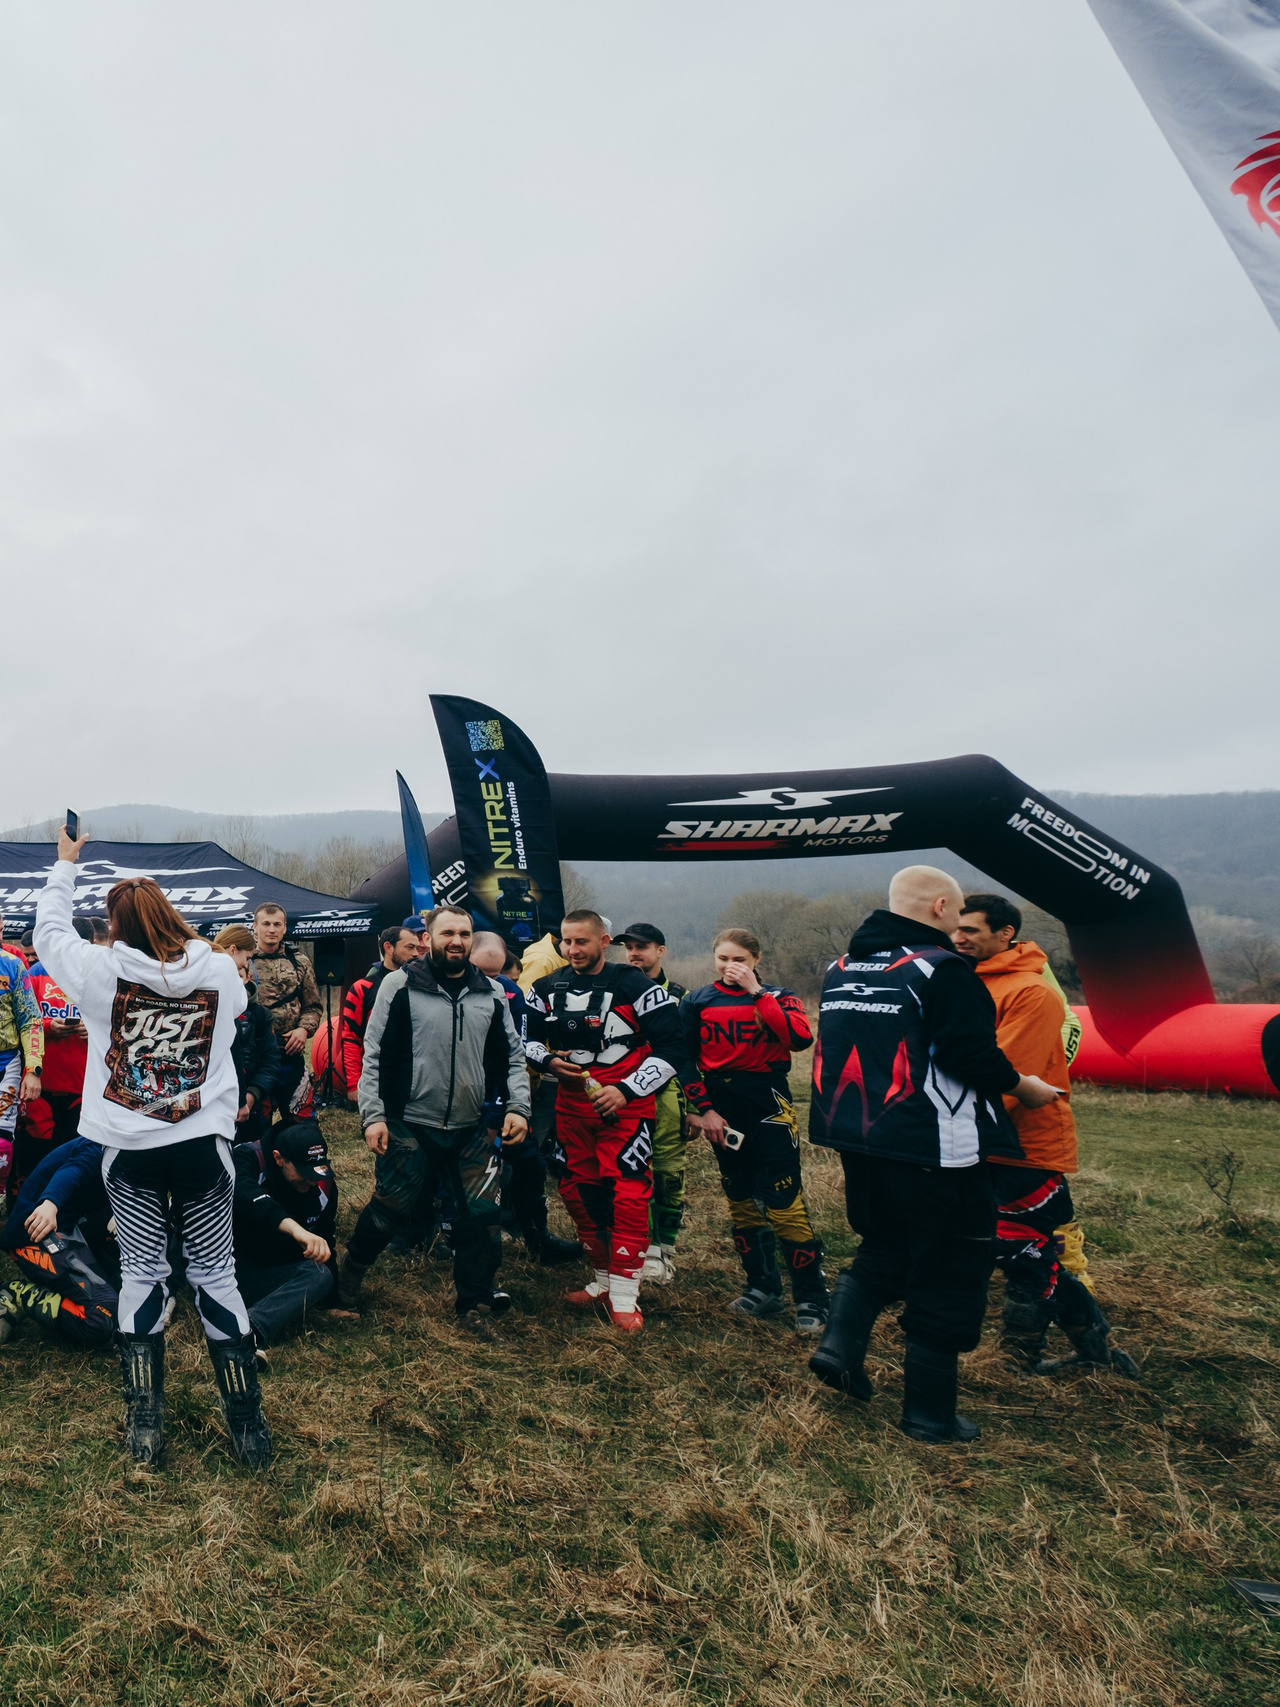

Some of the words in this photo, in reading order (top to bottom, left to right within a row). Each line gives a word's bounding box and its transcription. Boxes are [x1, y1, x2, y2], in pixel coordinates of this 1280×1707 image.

[474, 757, 515, 869] NITREX
[506, 781, 523, 828] vitamins
[657, 812, 904, 839] SHARMAX
[803, 834, 889, 847] MOTORS
[1021, 797, 1128, 870] FREEDOM
[1129, 864, 1151, 884] IN
[514, 829, 527, 869] Enduro
[1006, 812, 1141, 900] MOTION
[431, 860, 465, 895] REED
[294, 918, 373, 929] SHARMAX
[502, 910, 533, 918] NITREX
[41, 1002, 70, 1018] Red
[820, 1001, 903, 1014] SHARMAX
[121, 1008, 211, 1043] JUST
[128, 1038, 211, 1066] CAT
